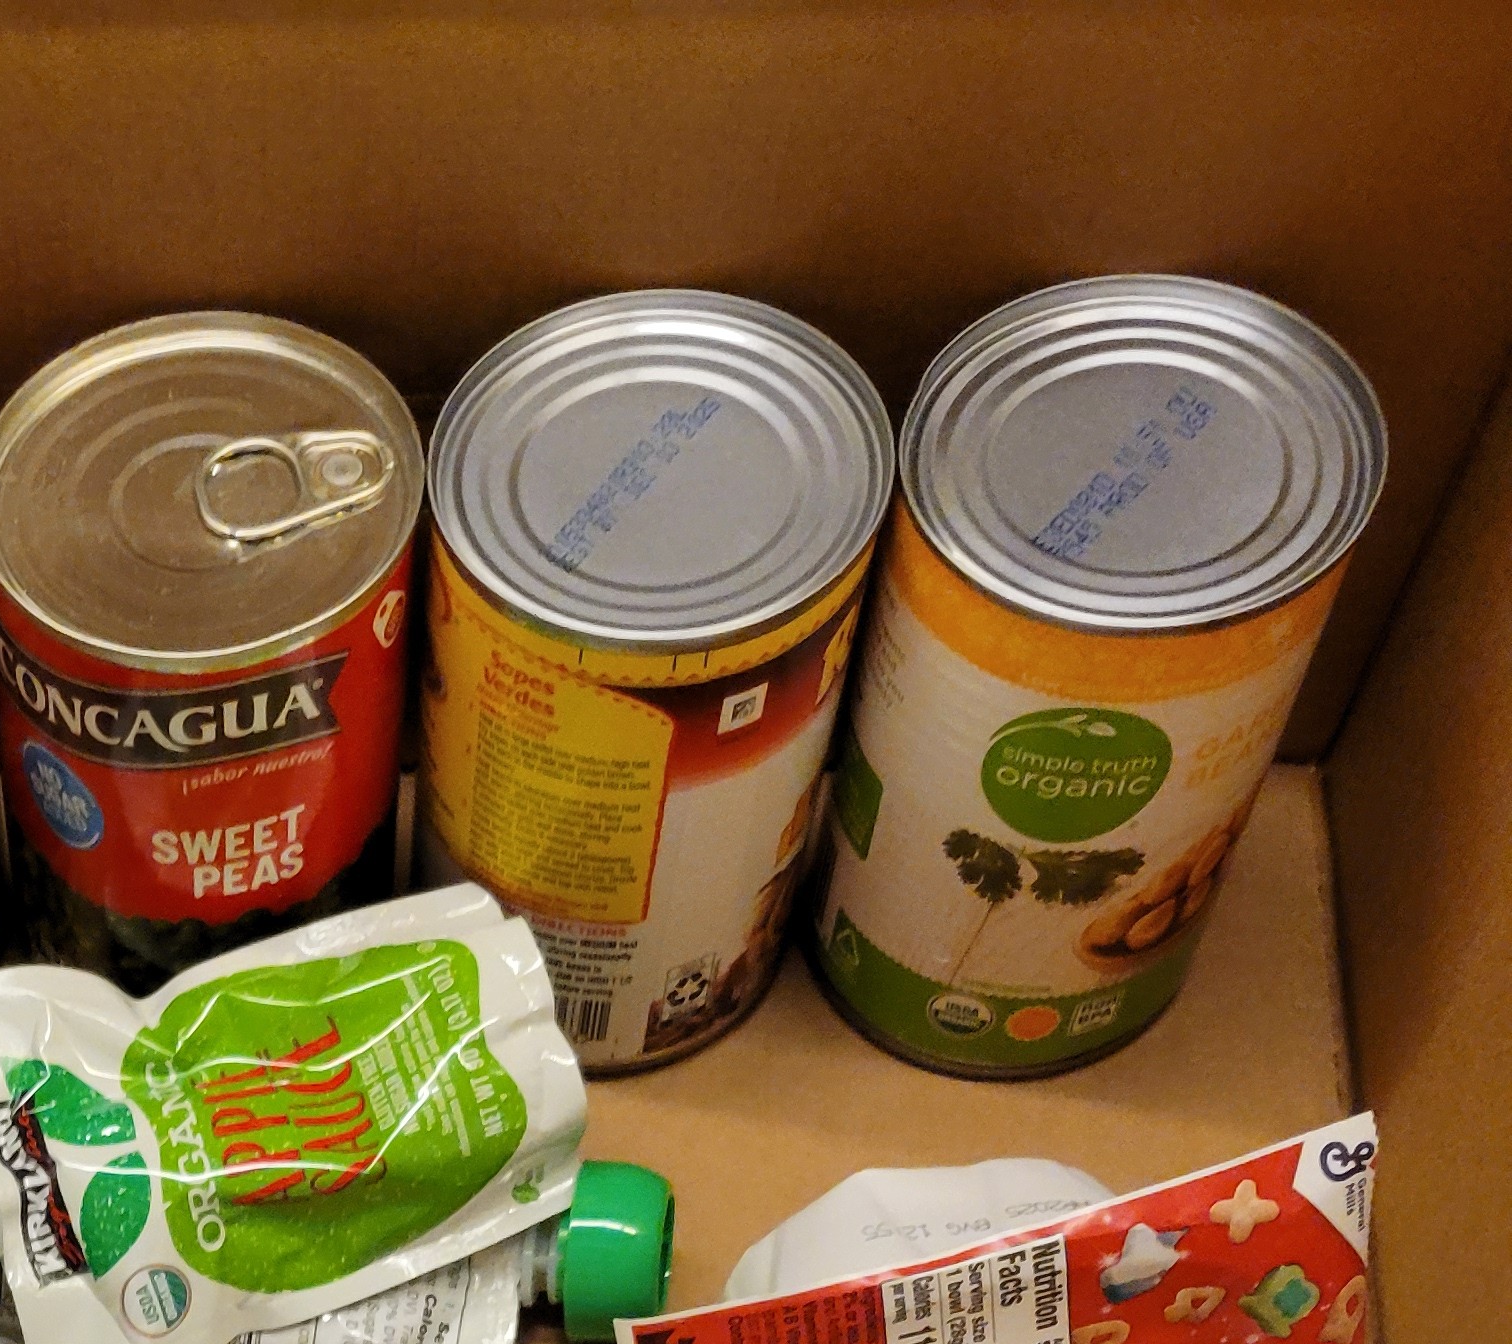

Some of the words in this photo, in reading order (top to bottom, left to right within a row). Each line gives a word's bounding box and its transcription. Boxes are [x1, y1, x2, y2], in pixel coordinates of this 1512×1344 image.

[483, 666, 555, 716] Verdes
[491, 651, 555, 695] Sopes
[996, 765, 1151, 799] organic
[1003, 745, 1085, 774] simple
[1090, 755, 1158, 775] truth
[151, 803, 305, 865] SWEET
[193, 842, 304, 899] PEAS
[263, 1011, 390, 1201] SAUCE
[141, 1053, 230, 1257] ORGANIC
[186, 1048, 312, 1221] APPLE
[945, 1281, 964, 1314] bowl
[947, 1268, 962, 1277] 1
[963, 1262, 989, 1314] Serving
[994, 1249, 1031, 1307] Facts
[1026, 1240, 1068, 1330] Nutrition
[136, 1283, 160, 1325] USDA
[910, 1275, 938, 1321] Calories
[970, 1316, 989, 1342] size
